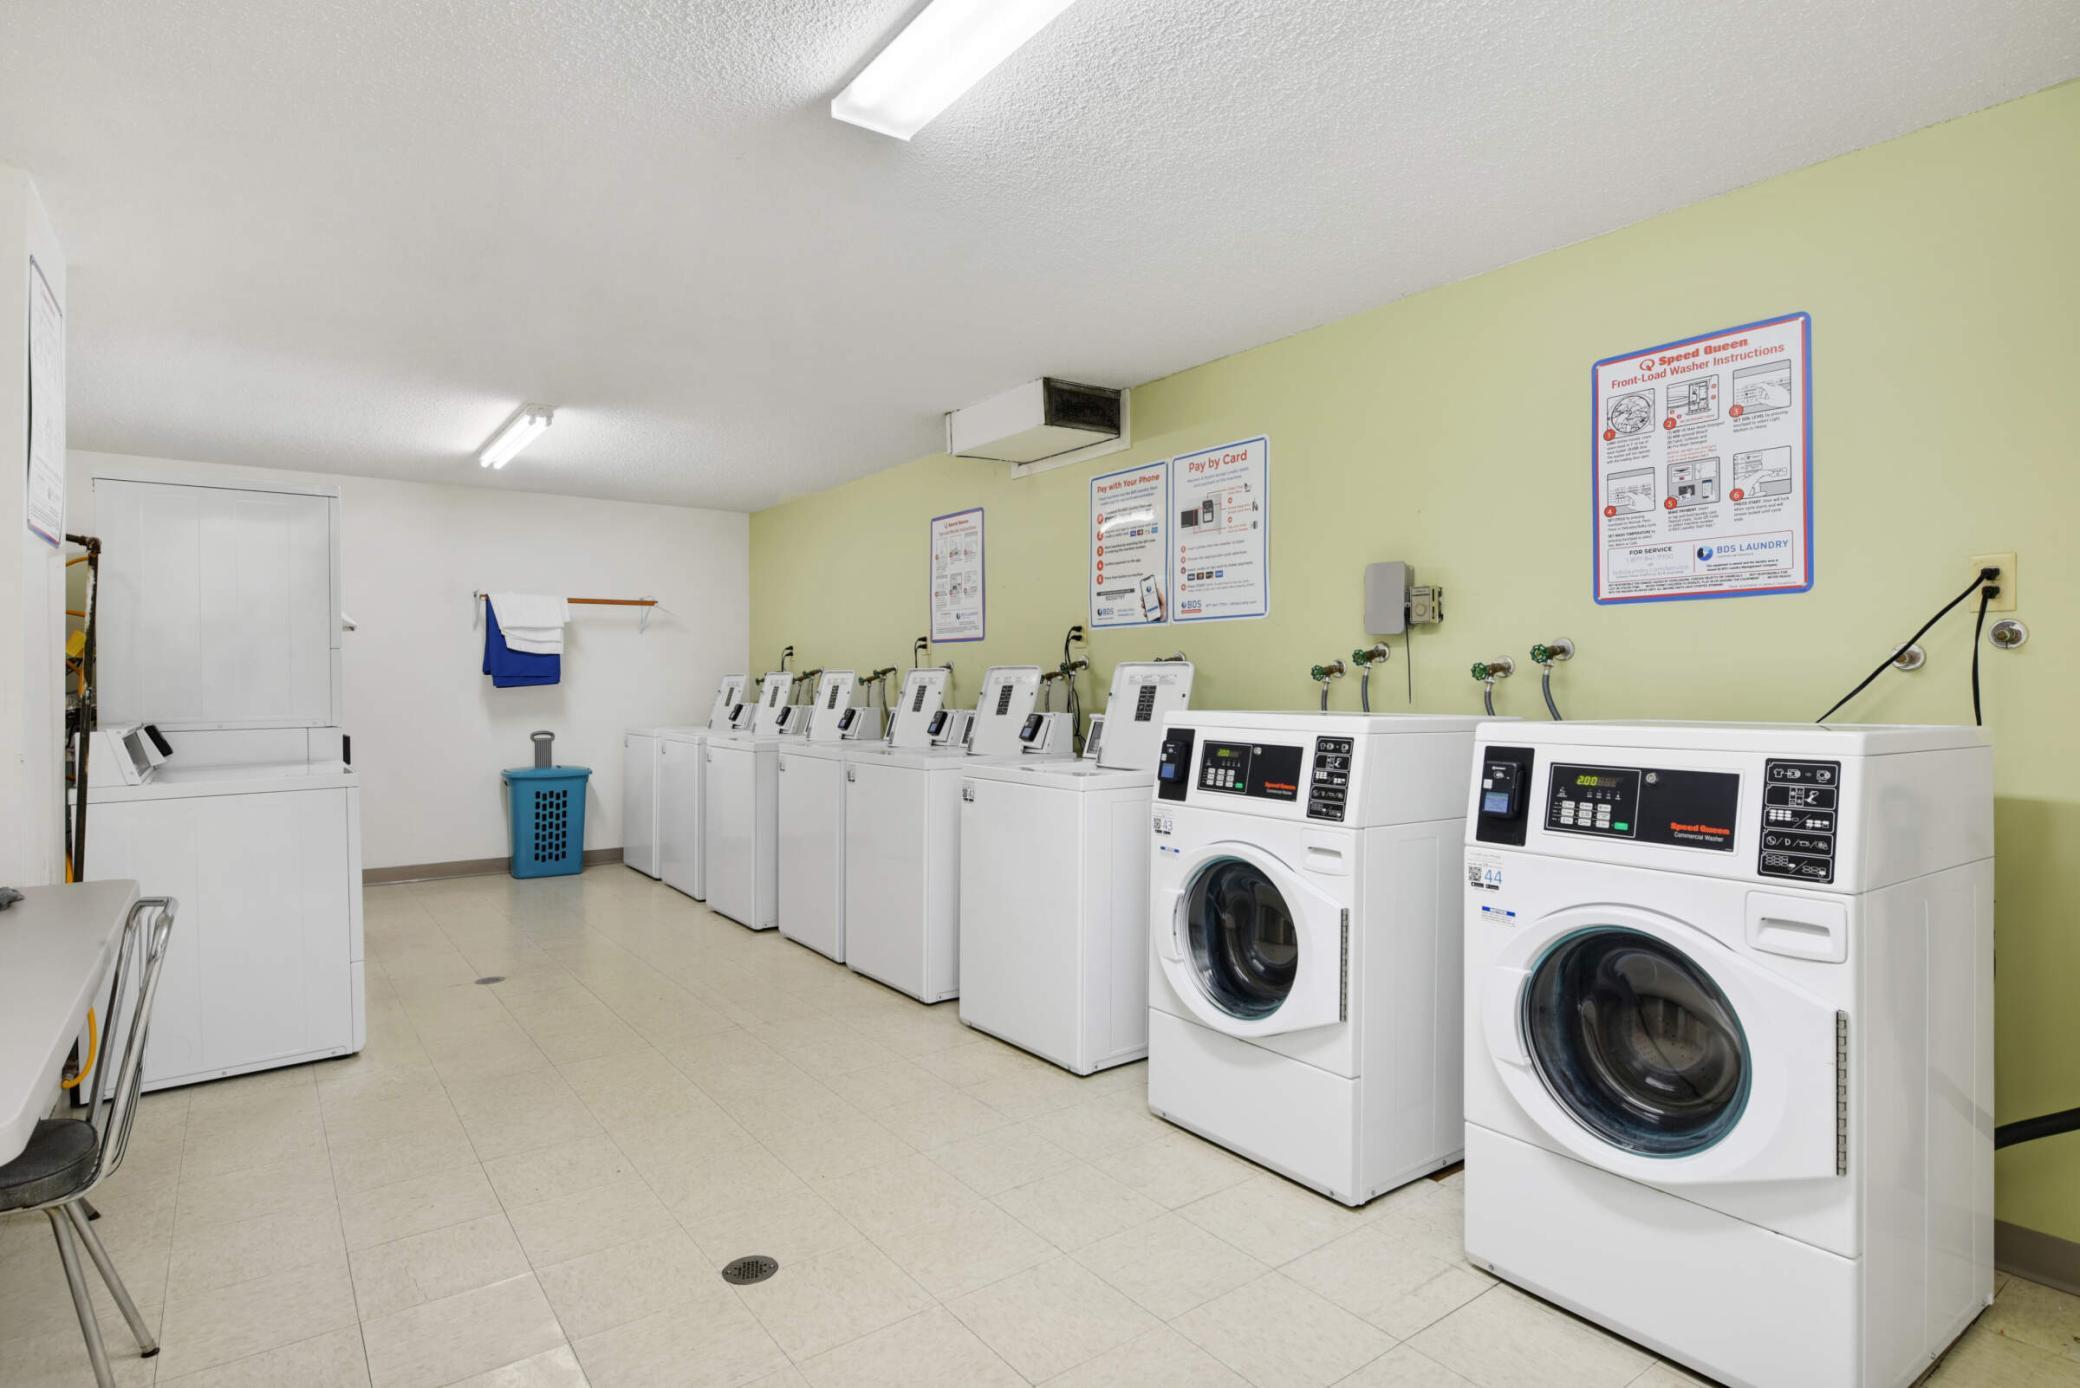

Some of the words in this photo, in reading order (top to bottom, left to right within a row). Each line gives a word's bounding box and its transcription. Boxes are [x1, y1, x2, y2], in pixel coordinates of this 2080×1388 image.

[1659, 346, 1699, 365] Speed
[1704, 338, 1749, 355] Queen
[1611, 369, 1666, 389] Front-Load
[1670, 361, 1709, 377] Washer
[1713, 344, 1785, 366] Instructions
[1188, 462, 1206, 473] Pay
[1208, 458, 1221, 470] by
[1223, 449, 1248, 465] Card
[1097, 486, 1107, 494] Pay
[1109, 481, 1122, 490] with
[1123, 478, 1137, 487] Your
[1139, 474, 1160, 484] Phone
[1644, 546, 1672, 555] SERVICE
[1717, 545, 1737, 554] BDS
[1740, 540, 1789, 552] LAUNDRY
[1187, 600, 1202, 609] BDS
[1163, 819, 1173, 831] 43
[1670, 822, 1699, 832] Speed
[1700, 825, 1730, 835] Queen
[1674, 831, 1704, 840] Commercial
[1704, 834, 1724, 843] Washer
[1484, 869, 1503, 885] 44
